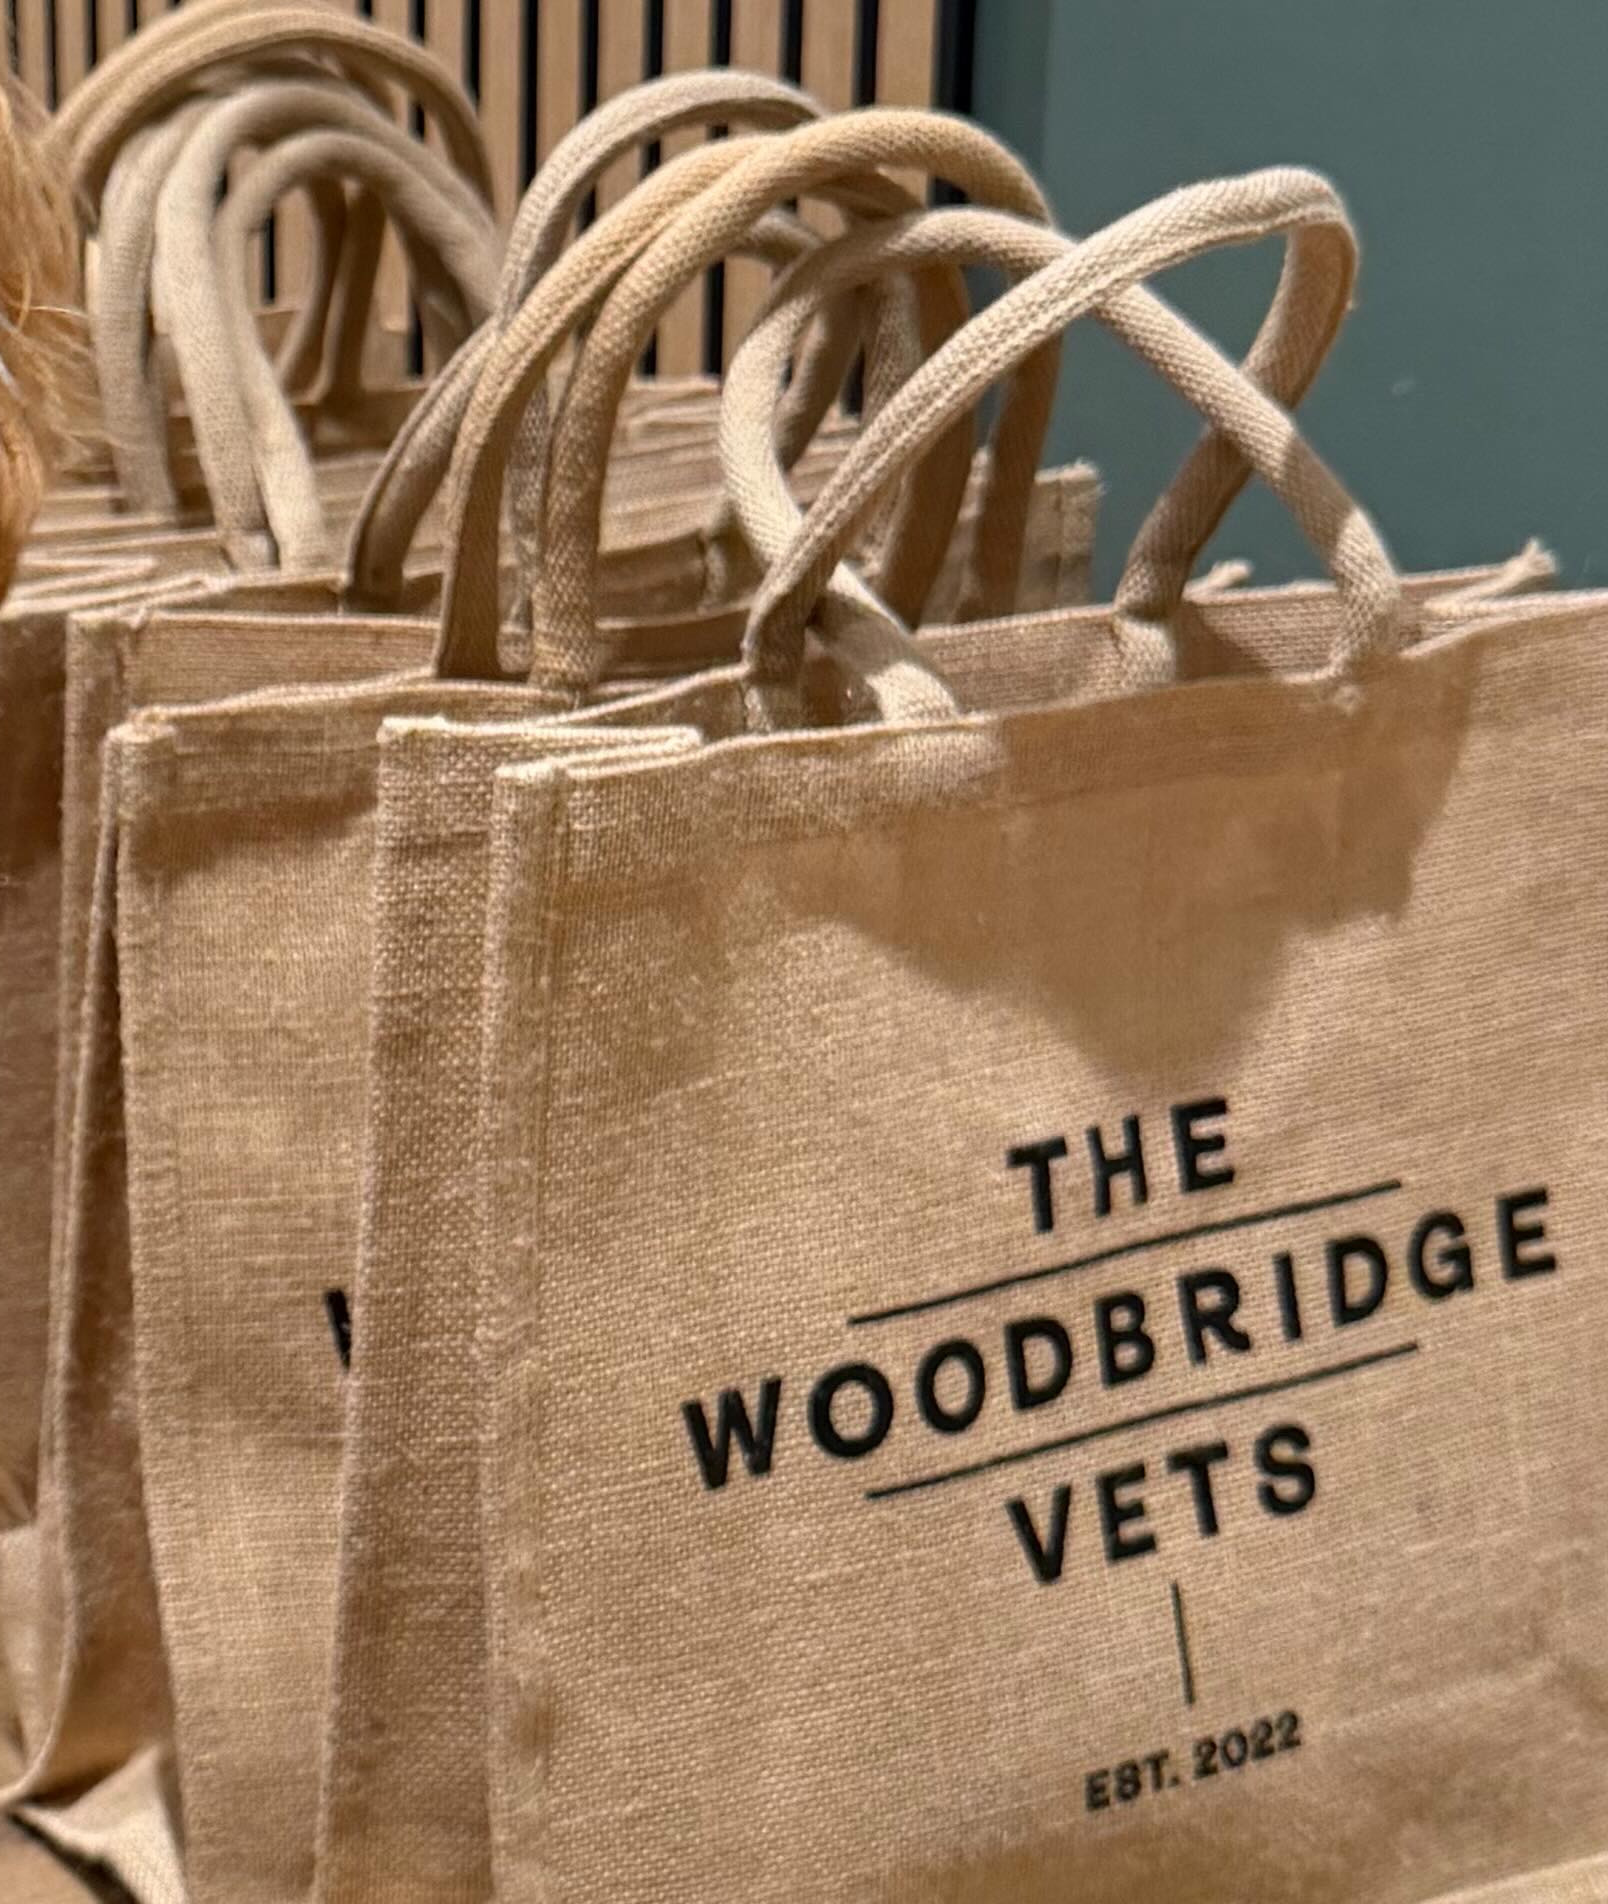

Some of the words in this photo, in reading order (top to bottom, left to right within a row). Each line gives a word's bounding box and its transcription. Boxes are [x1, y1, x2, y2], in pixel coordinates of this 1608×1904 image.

[1006, 1095, 1238, 1235] THE
[680, 1186, 1560, 1492] WOODBRIDGE
[1005, 1422, 1318, 1586] VETS
[1084, 1749, 1182, 1814] EST.
[1192, 1710, 1303, 1782] 2022
